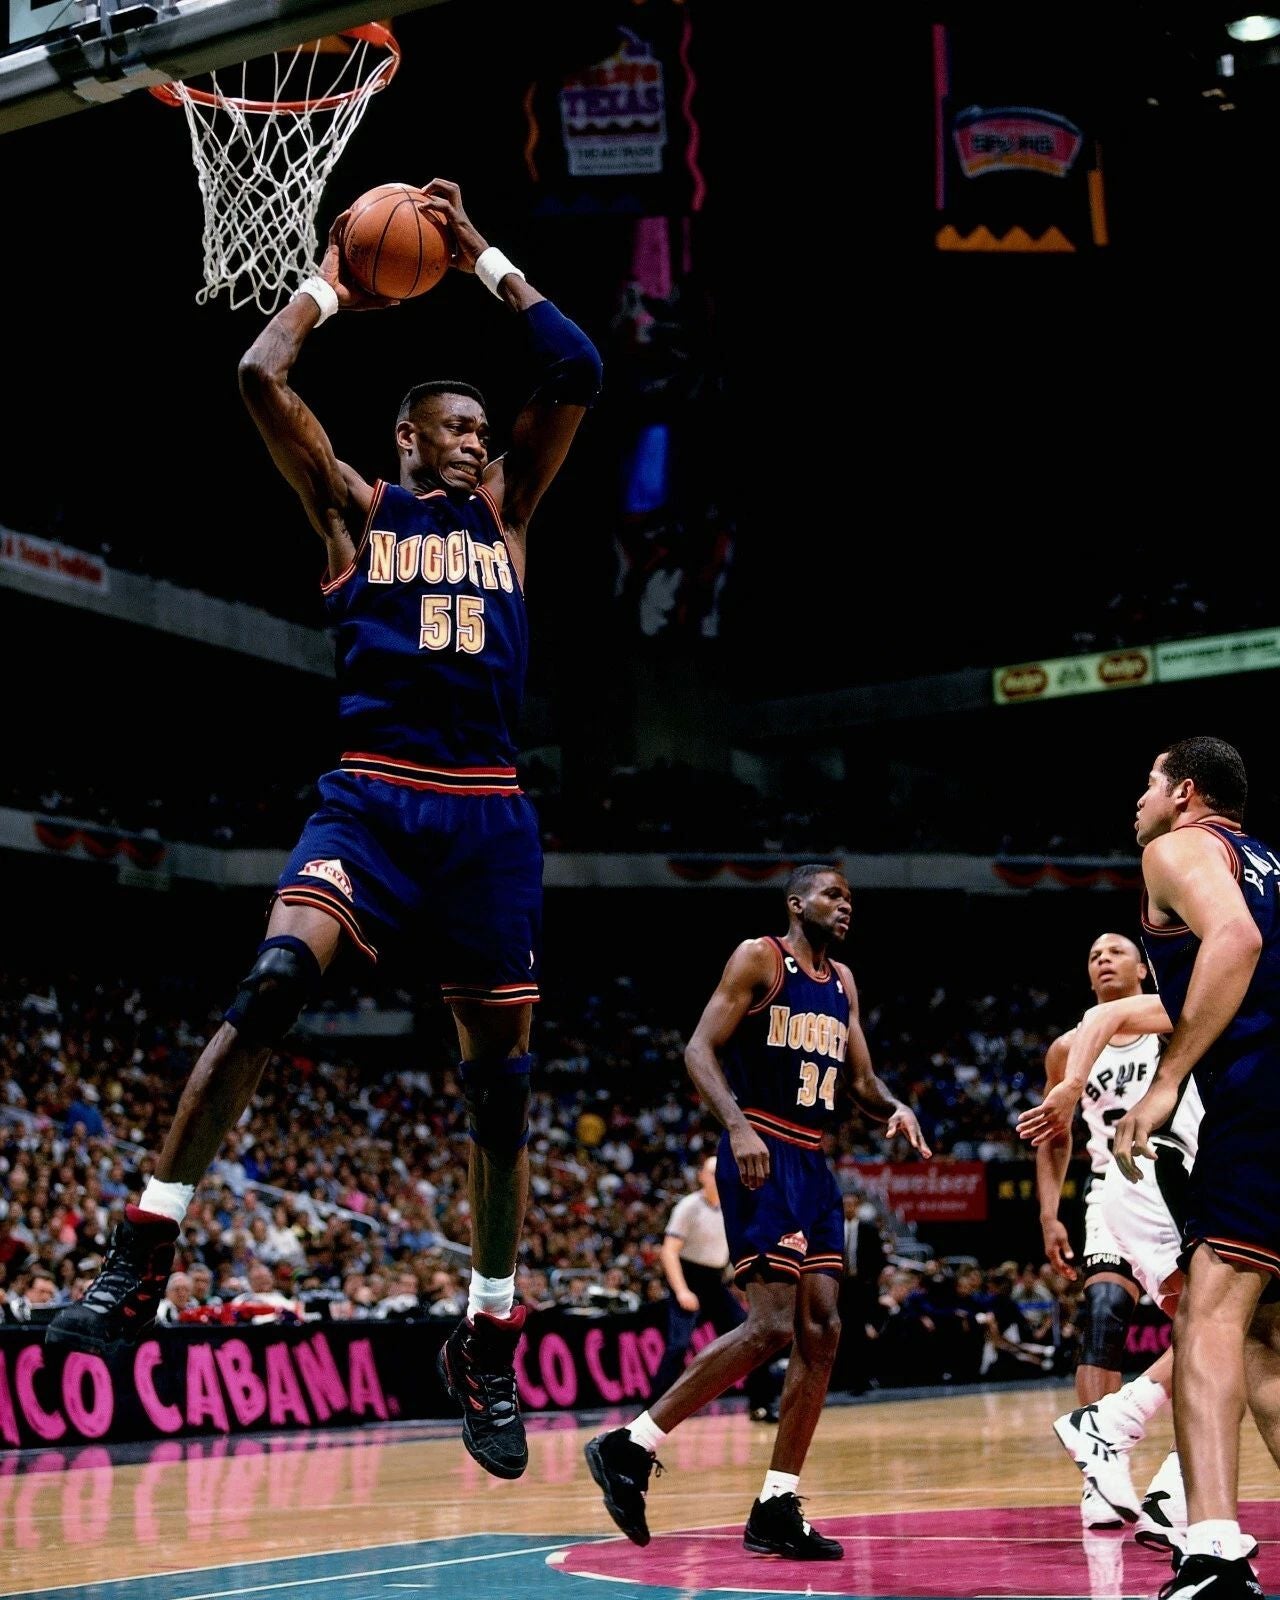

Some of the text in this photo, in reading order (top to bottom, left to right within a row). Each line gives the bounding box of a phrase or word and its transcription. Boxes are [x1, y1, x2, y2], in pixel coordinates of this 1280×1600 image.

[368, 530, 514, 594] NUGGTS
[419, 594, 486, 655] 55
[784, 956, 798, 974] C
[796, 1060, 837, 1111] 34
